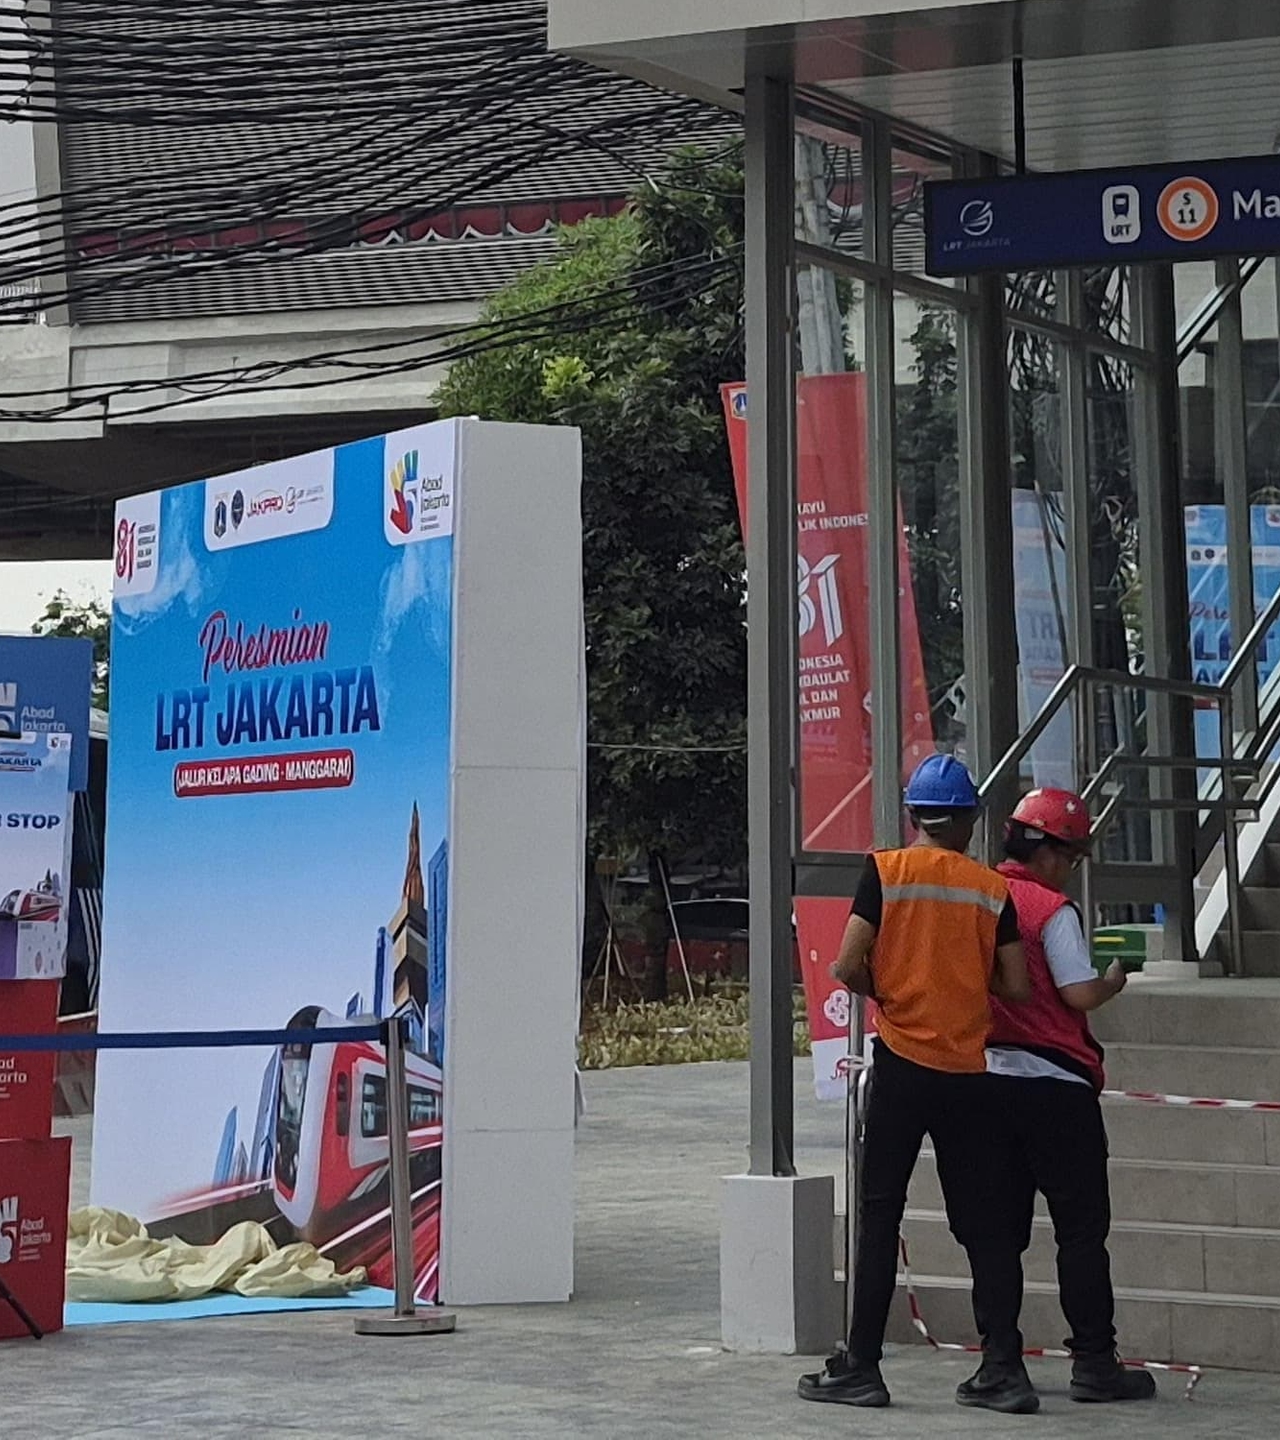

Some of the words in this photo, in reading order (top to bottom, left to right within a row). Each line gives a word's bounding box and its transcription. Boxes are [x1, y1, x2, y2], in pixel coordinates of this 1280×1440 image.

[1181, 191, 1192, 206] S
[1177, 208, 1198, 224] 11
[1110, 224, 1132, 237] LRT
[199, 608, 331, 684] Peresmian
[811, 689, 838, 703] DAN
[21, 706, 55, 719] Abad
[155, 684, 210, 752] LRT
[216, 665, 381, 746] JAKARTA
[242, 762, 279, 784] GADING
[7, 813, 61, 830] STOP
[21, 1216, 44, 1231] Abad
